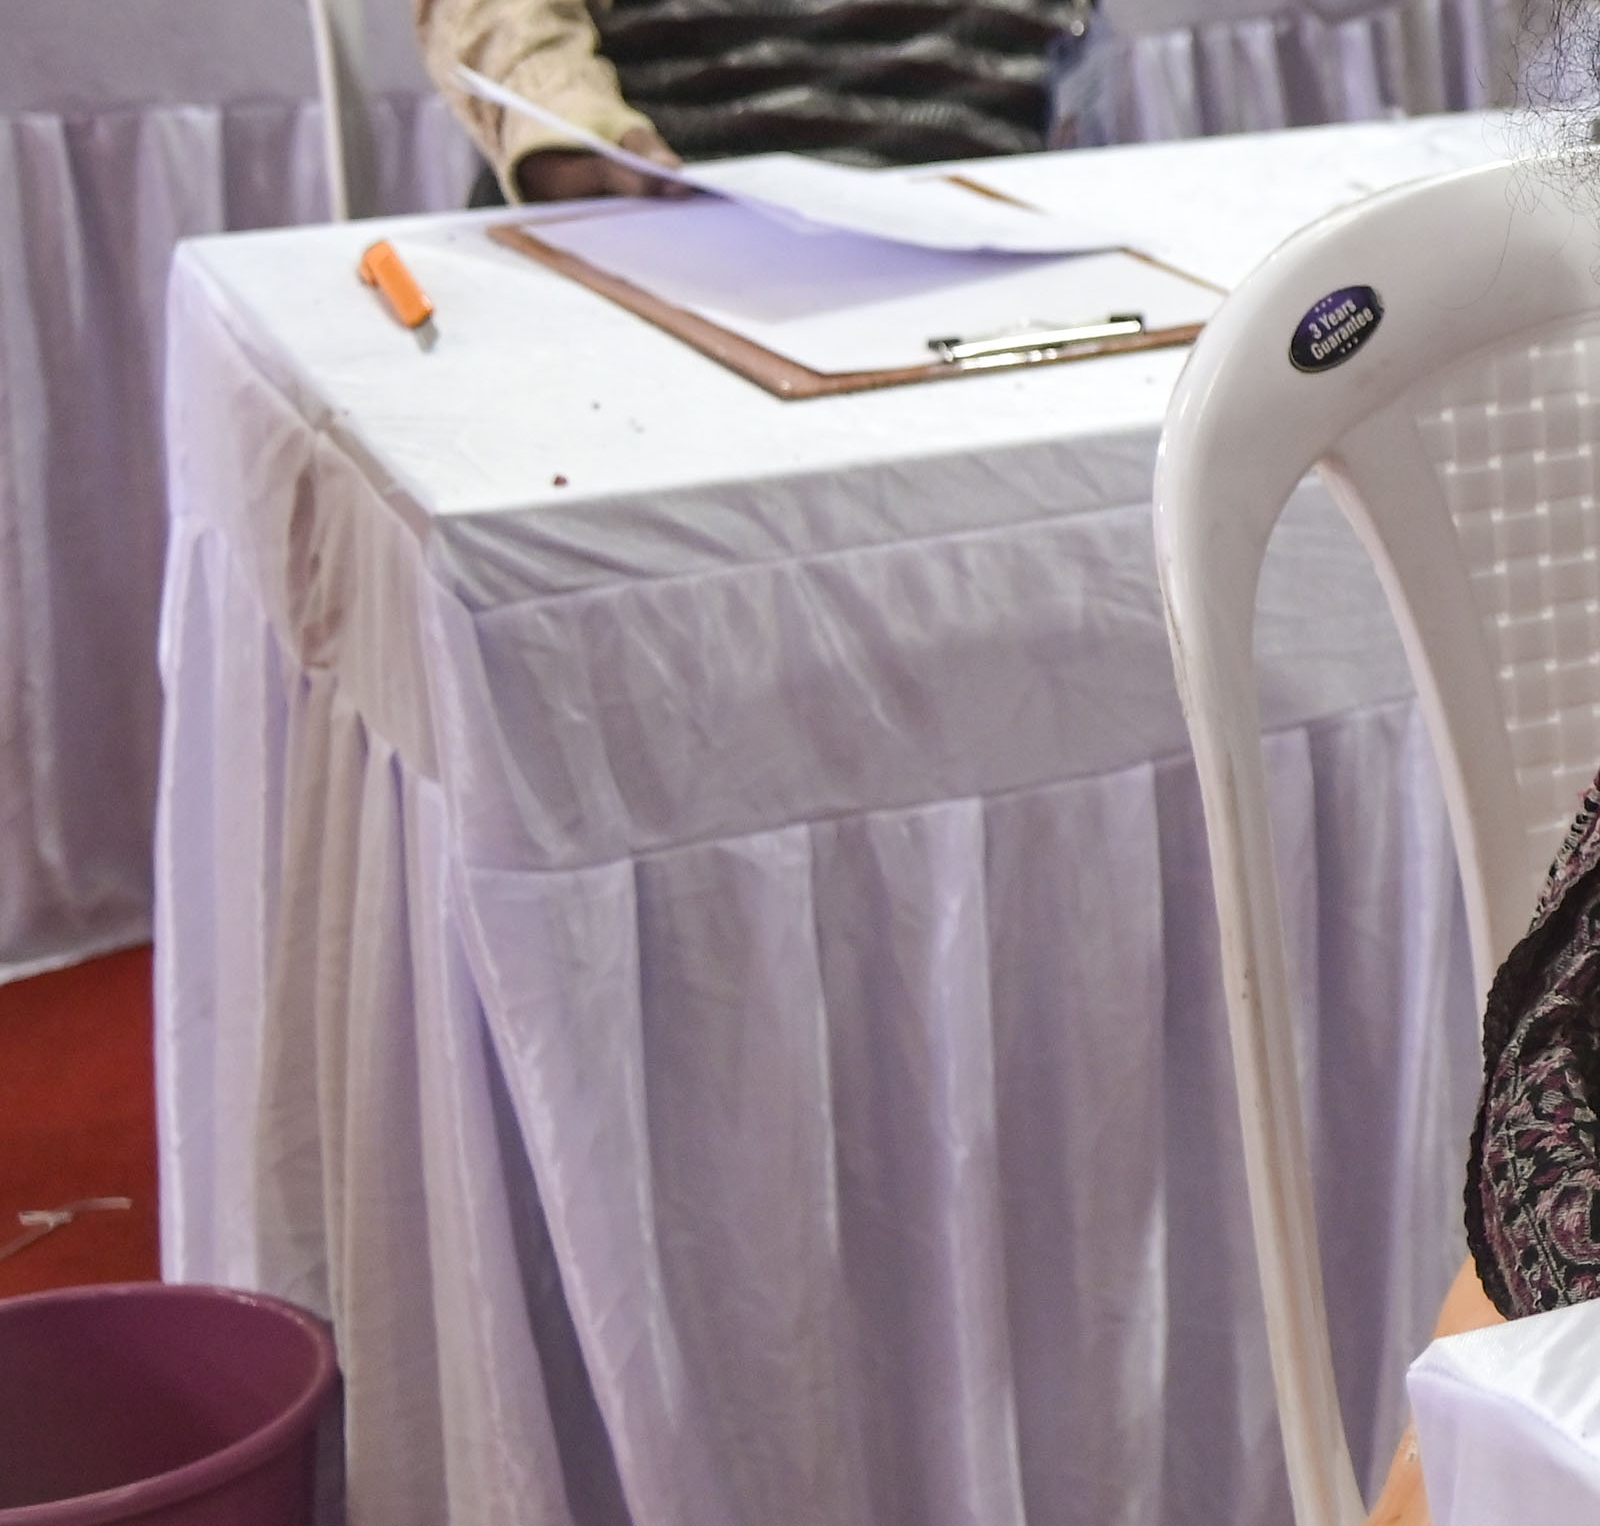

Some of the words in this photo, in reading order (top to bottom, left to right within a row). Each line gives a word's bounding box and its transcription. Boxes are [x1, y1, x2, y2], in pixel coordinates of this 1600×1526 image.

[1308, 321, 1322, 340] 3
[1319, 297, 1357, 332] Years
[1310, 305, 1375, 361] Guarantee
